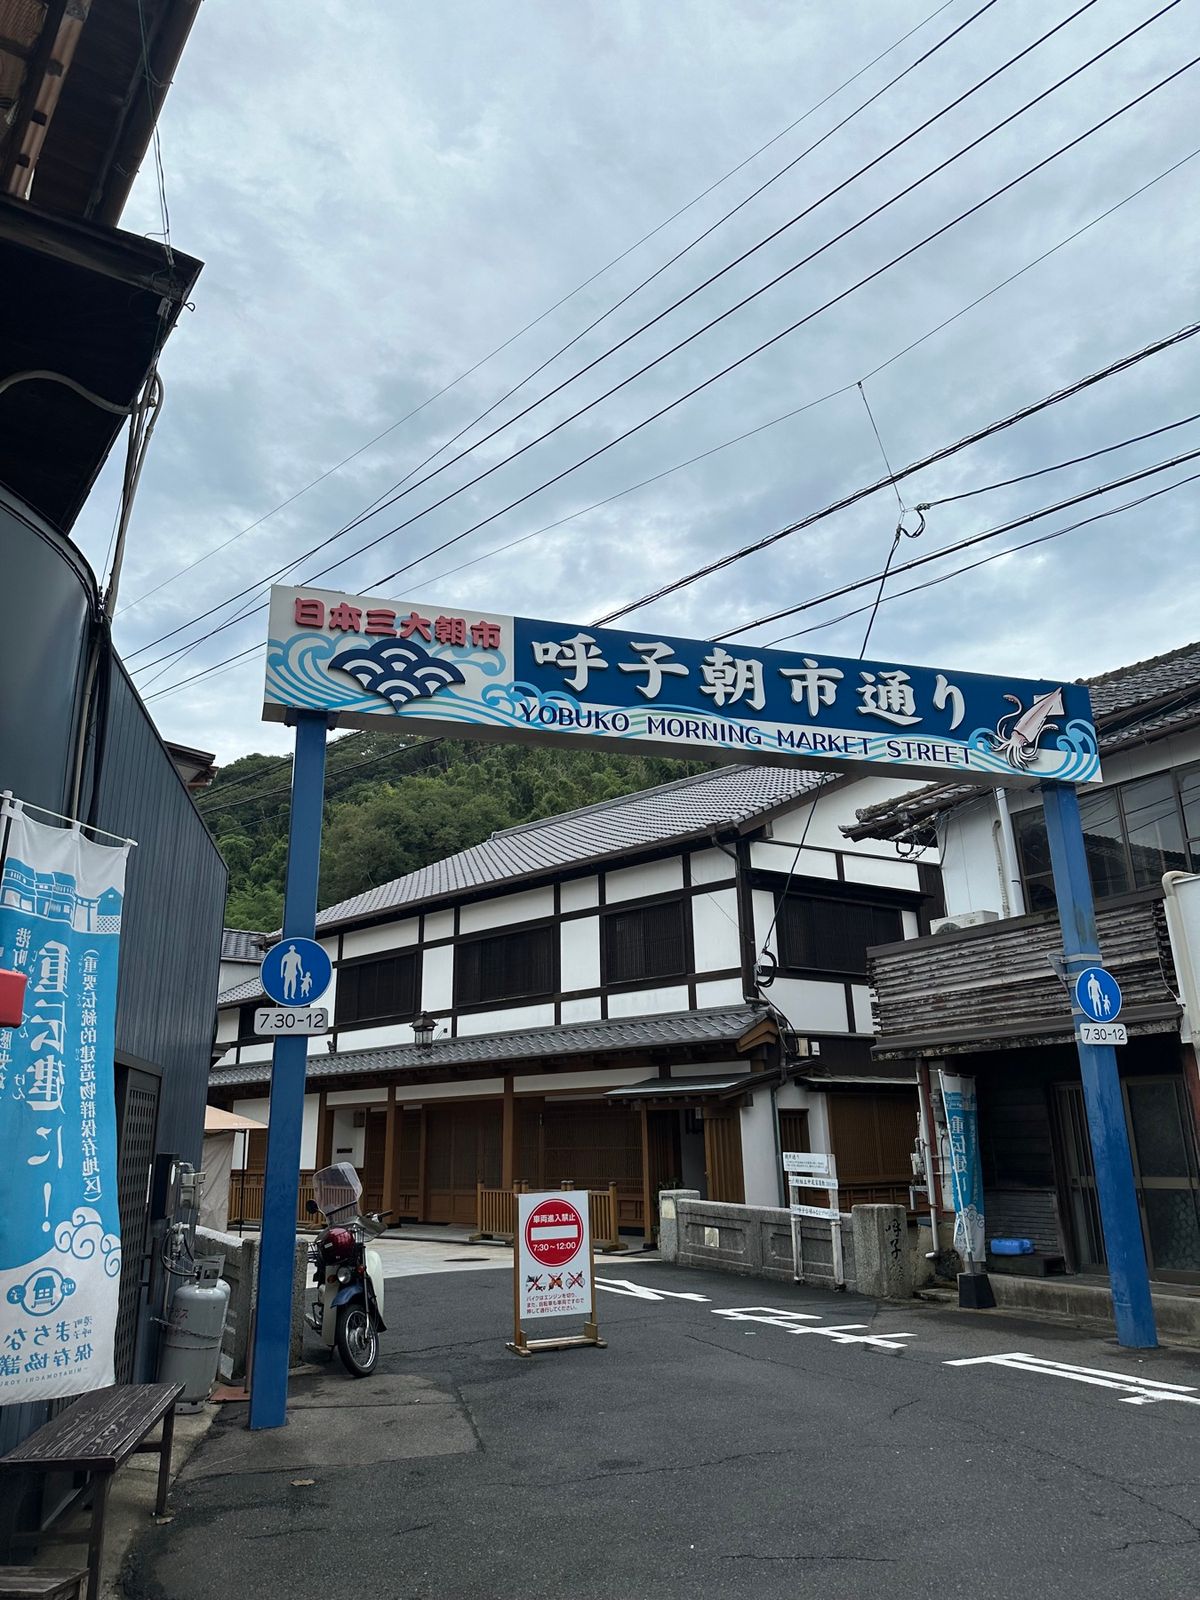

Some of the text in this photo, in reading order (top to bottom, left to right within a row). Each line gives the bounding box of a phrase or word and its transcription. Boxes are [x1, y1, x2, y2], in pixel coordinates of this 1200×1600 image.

[294, 597, 502, 650] 日本三大朝市
[530, 631, 967, 732] 呼子朝市通り
[519, 701, 973, 766] YOBUKO MORNING MARKET STREET
[259, 1013, 325, 1029] 7.30-12
[1083, 1028, 1126, 1041] 7.30-12
[532, 1213, 577, 1224] 車両進入禁止
